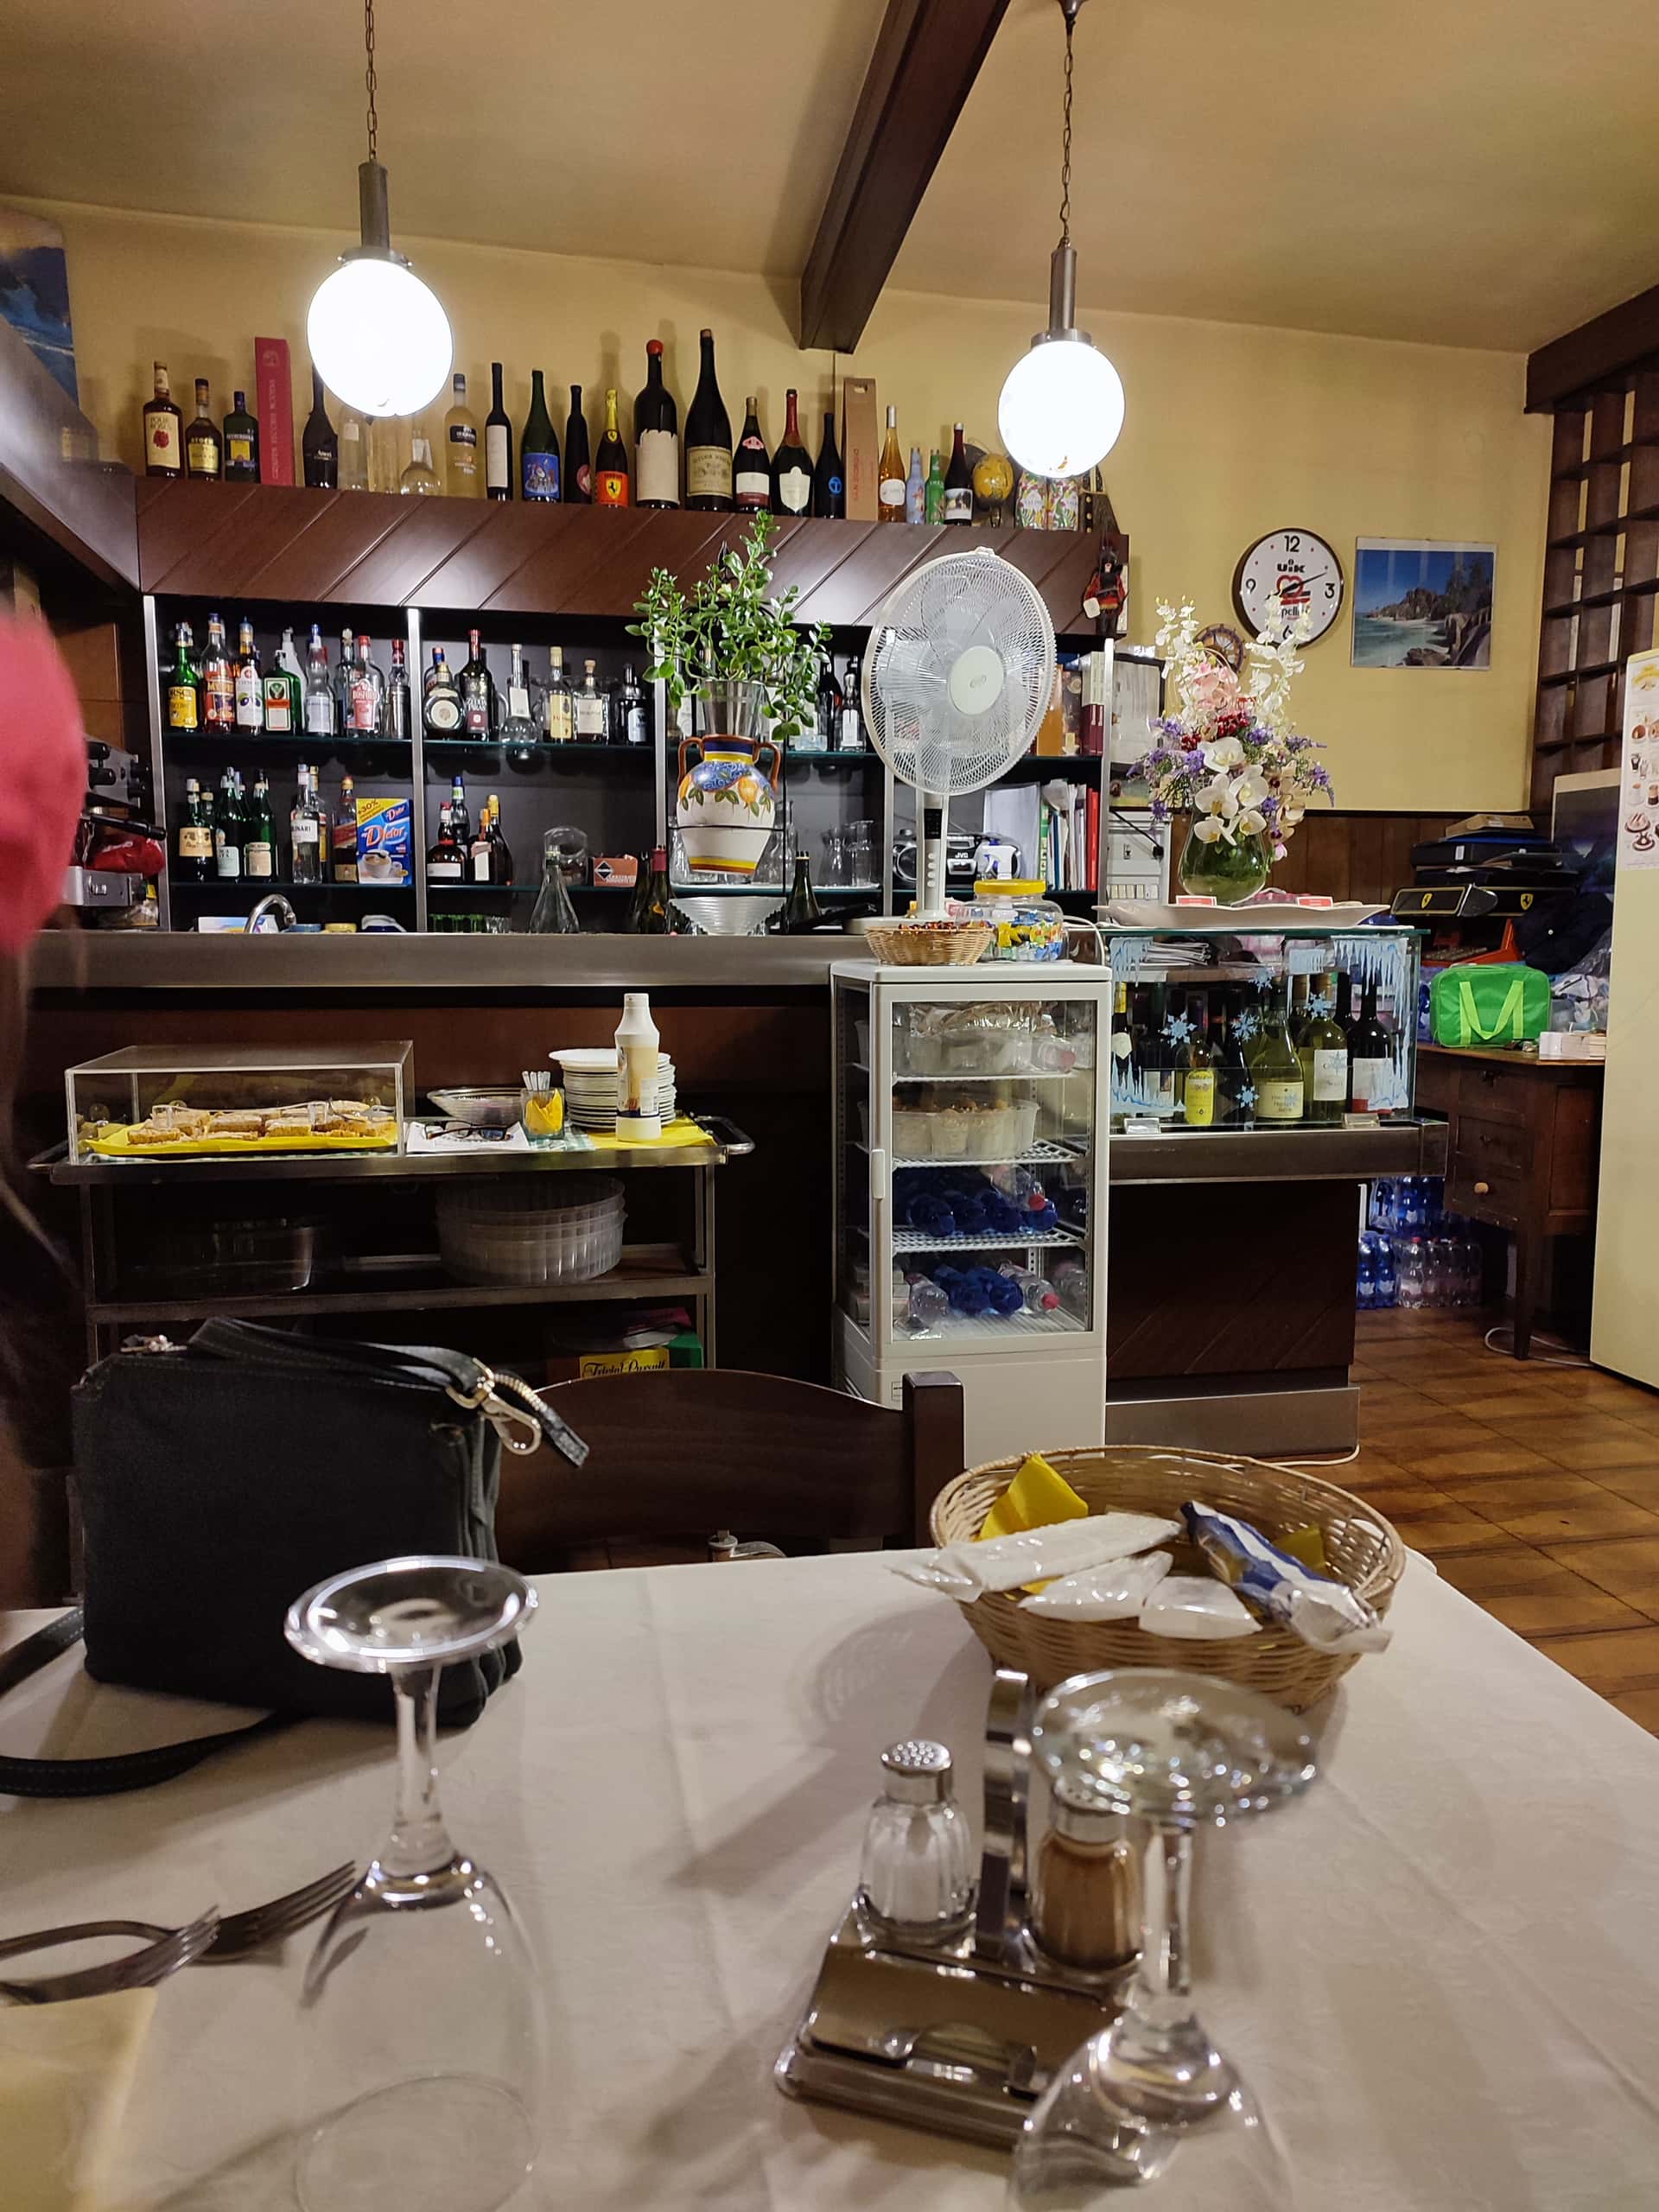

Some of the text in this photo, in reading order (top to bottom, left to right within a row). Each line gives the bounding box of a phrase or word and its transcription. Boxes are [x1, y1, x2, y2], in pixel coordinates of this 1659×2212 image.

[1284, 535, 1300, 553] 12
[1245, 578, 1256, 594] 9
[1325, 582, 1335, 600] 3
